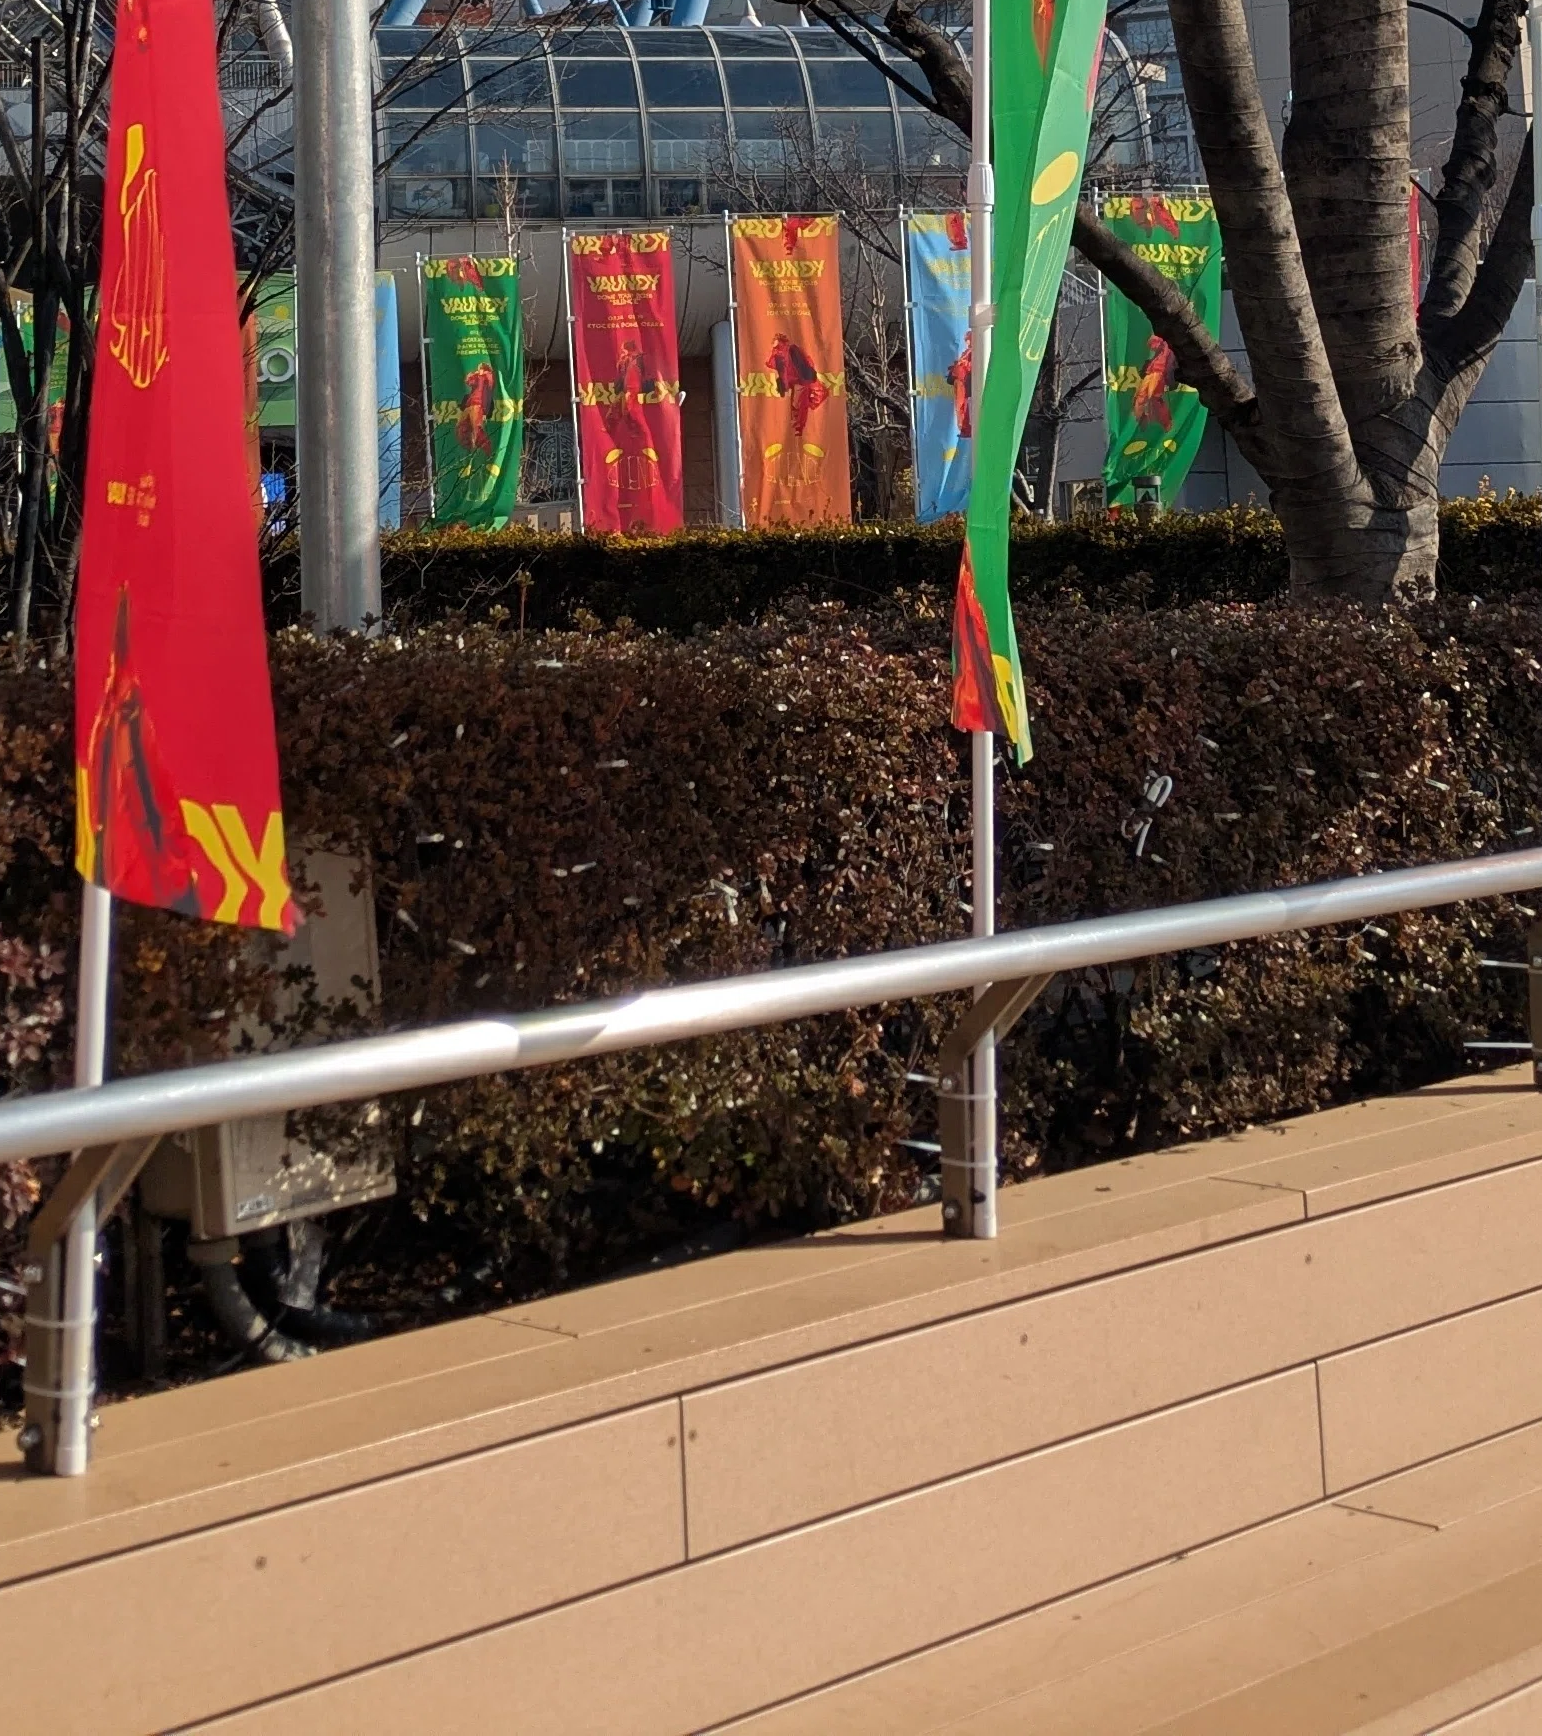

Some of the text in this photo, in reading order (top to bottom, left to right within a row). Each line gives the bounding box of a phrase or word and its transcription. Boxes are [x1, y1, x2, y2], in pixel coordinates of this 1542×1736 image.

[748, 259, 825, 279] VAUNDY
[586, 273, 662, 294] VAUNDY
[440, 295, 510, 315] VAUNDY
